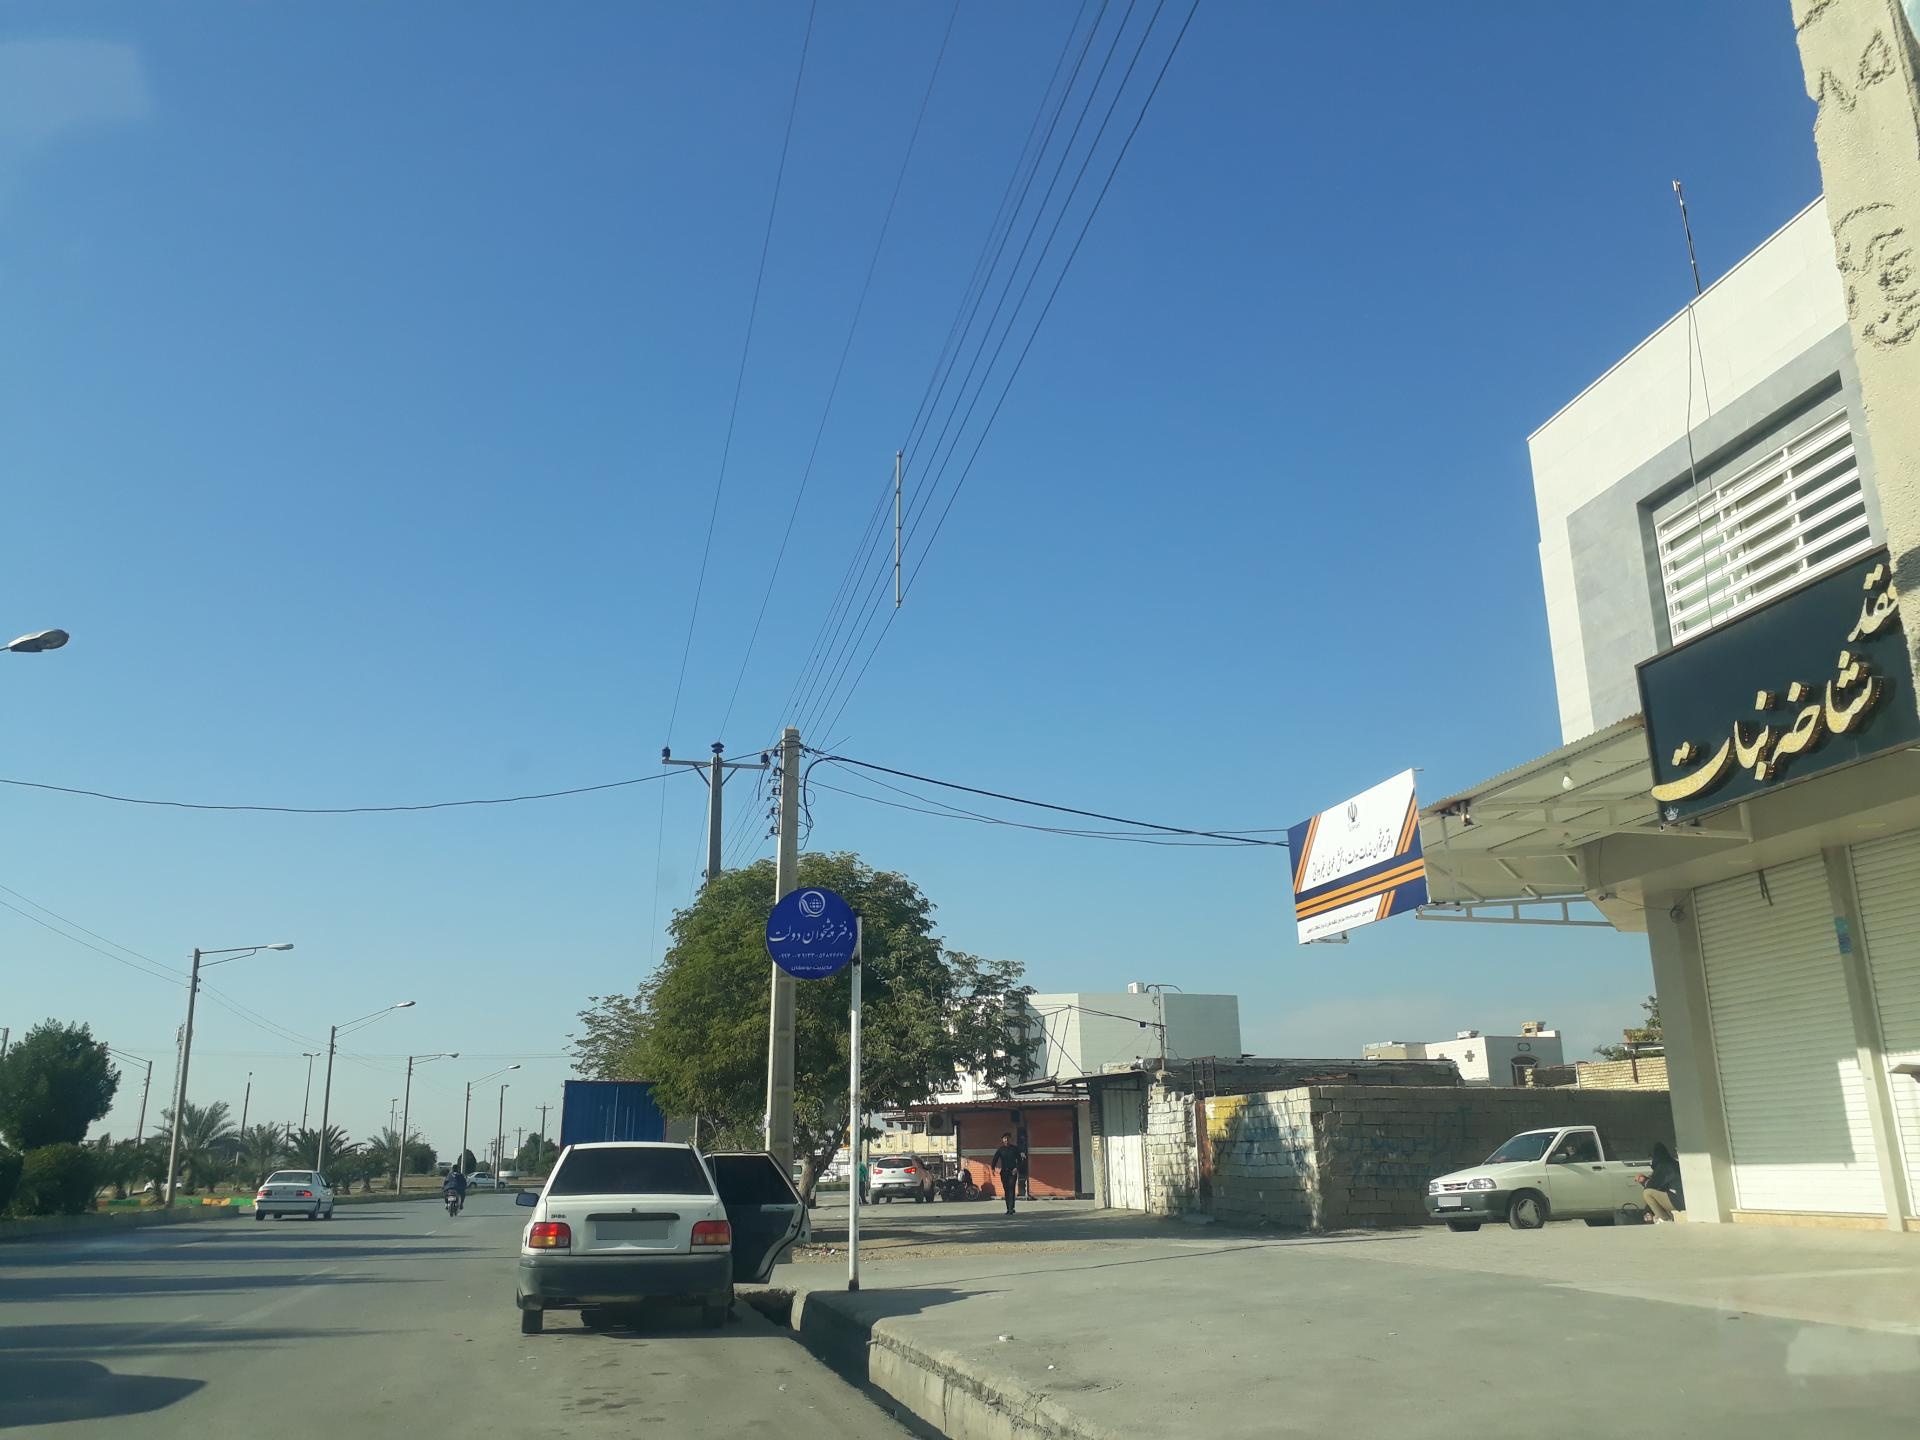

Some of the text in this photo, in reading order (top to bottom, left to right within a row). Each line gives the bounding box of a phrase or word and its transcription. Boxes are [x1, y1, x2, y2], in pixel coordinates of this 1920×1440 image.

[1651, 689, 1769, 802] نبات
[1771, 649, 1874, 766] شاخه
[768, 917, 853, 945] دفتر پیشخوان دولت
